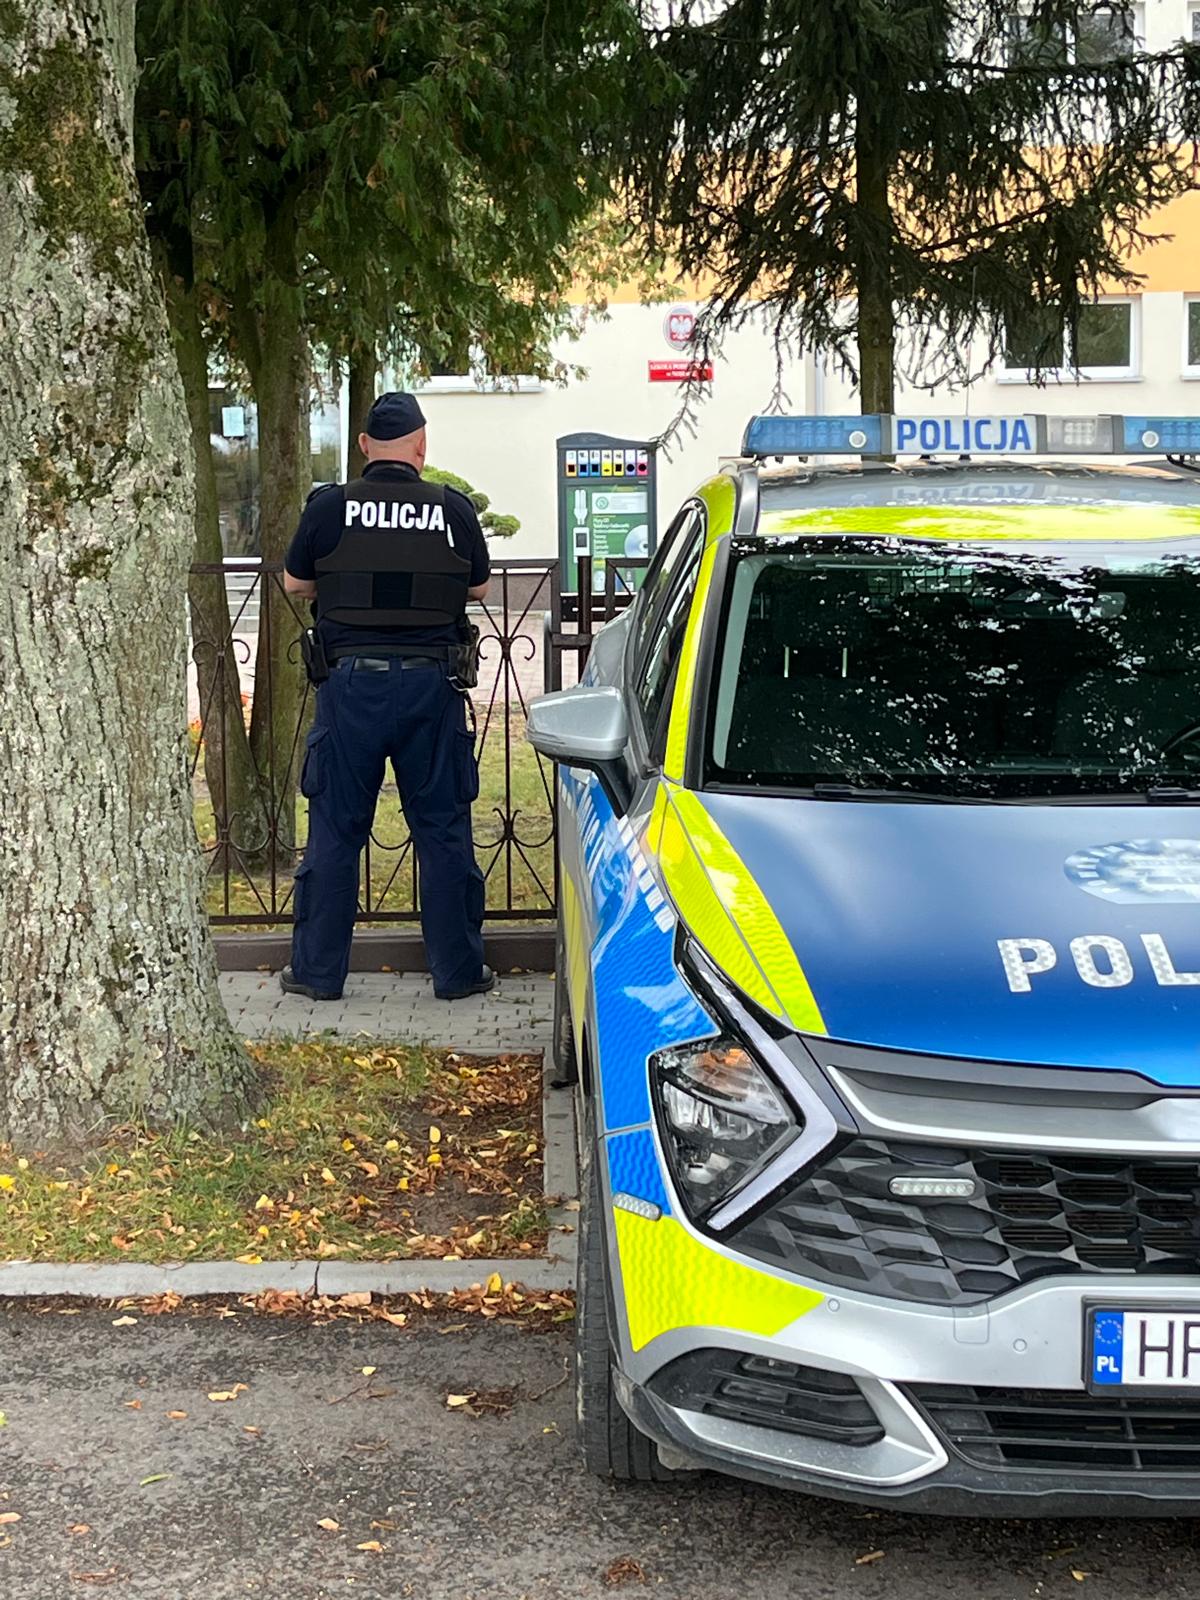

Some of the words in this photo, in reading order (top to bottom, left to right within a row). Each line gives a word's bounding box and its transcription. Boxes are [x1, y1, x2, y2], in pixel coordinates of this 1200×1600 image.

[896, 419, 1032, 451] POLICJA
[345, 500, 445, 531] POLICJA
[996, 933, 1200, 993] POL
[1096, 1355, 1120, 1373] PL
